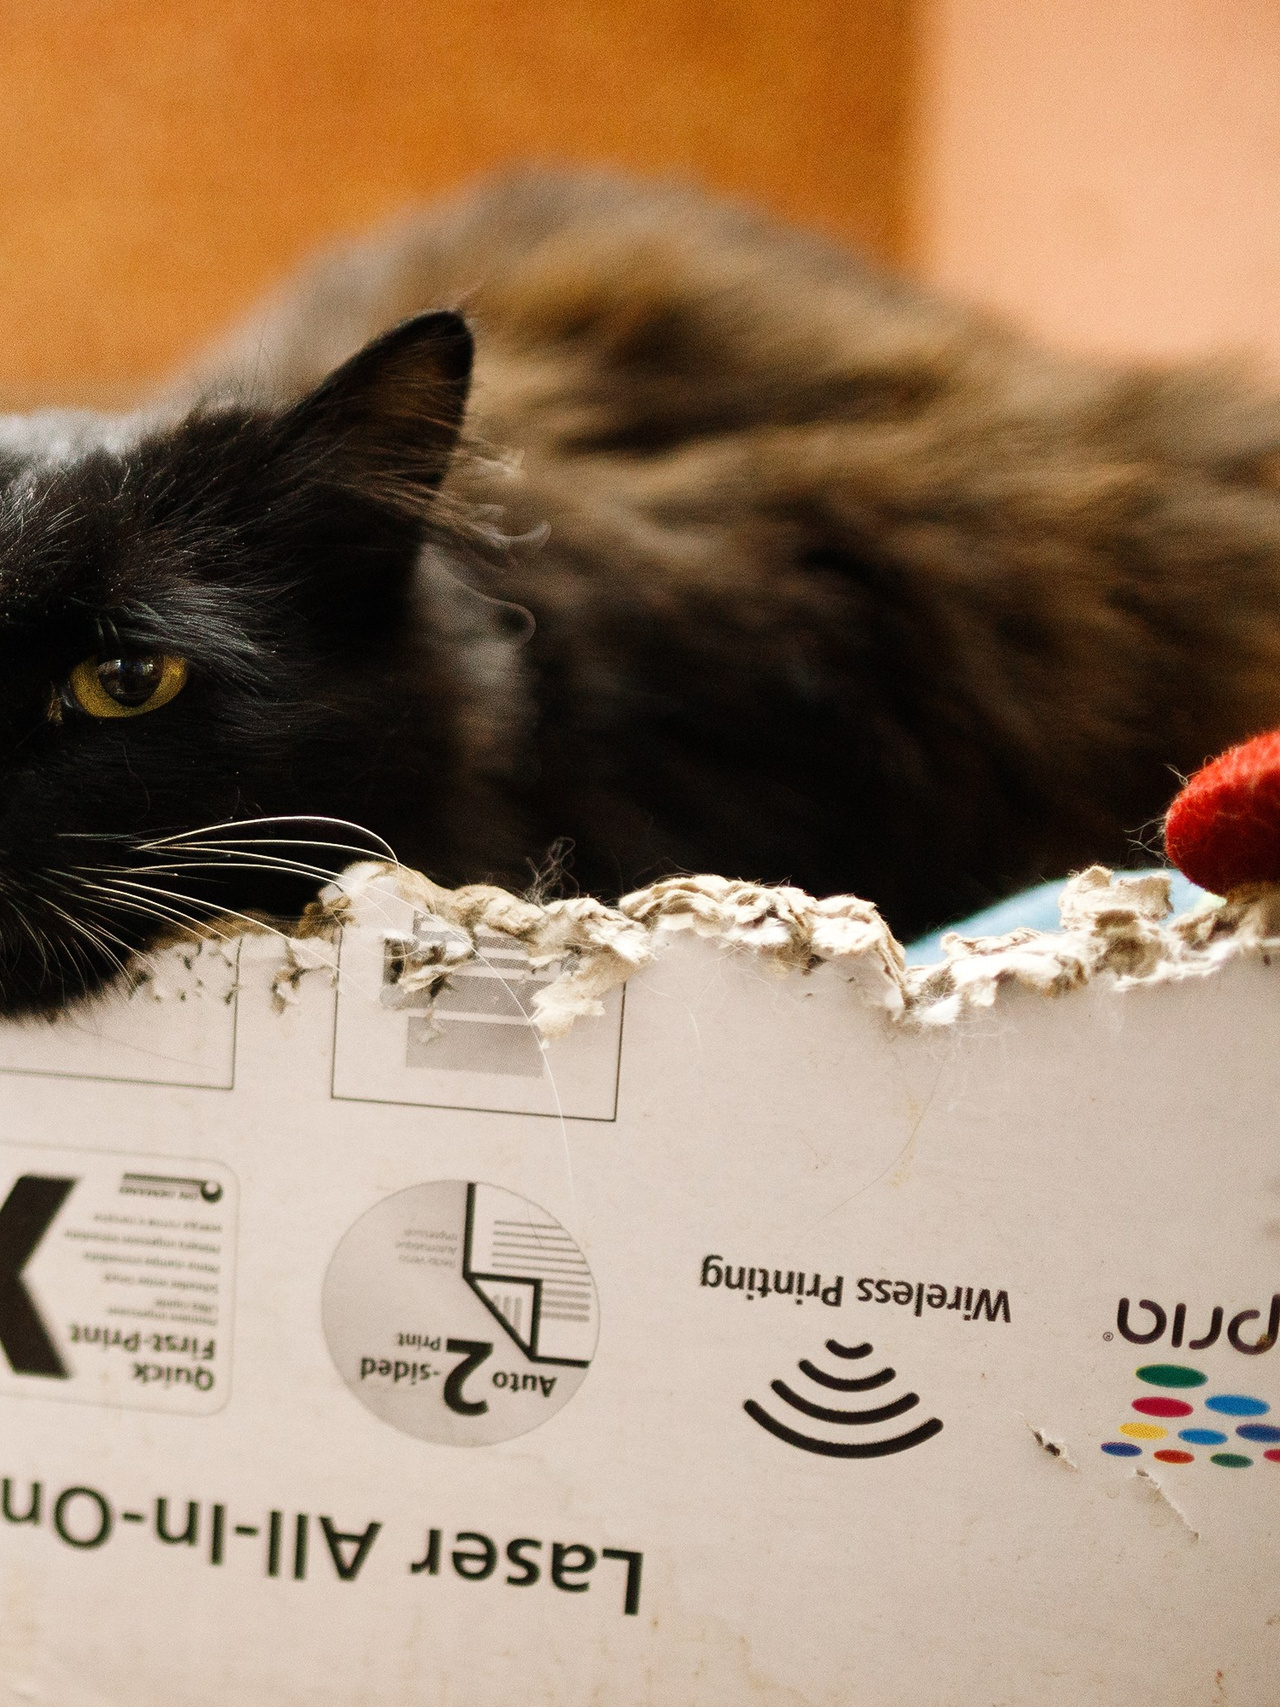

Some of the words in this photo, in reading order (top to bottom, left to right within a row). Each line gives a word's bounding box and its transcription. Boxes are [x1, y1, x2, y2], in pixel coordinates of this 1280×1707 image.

[700, 1254, 844, 1308] Printing
[856, 1276, 1012, 1324] Wireless
[69, 1322, 216, 1361] First-Print
[397, 1332, 441, 1351] Print
[133, 1361, 215, 1392] Quick
[492, 1370, 558, 1398] Auto
[410, 1526, 644, 1616] Laser
